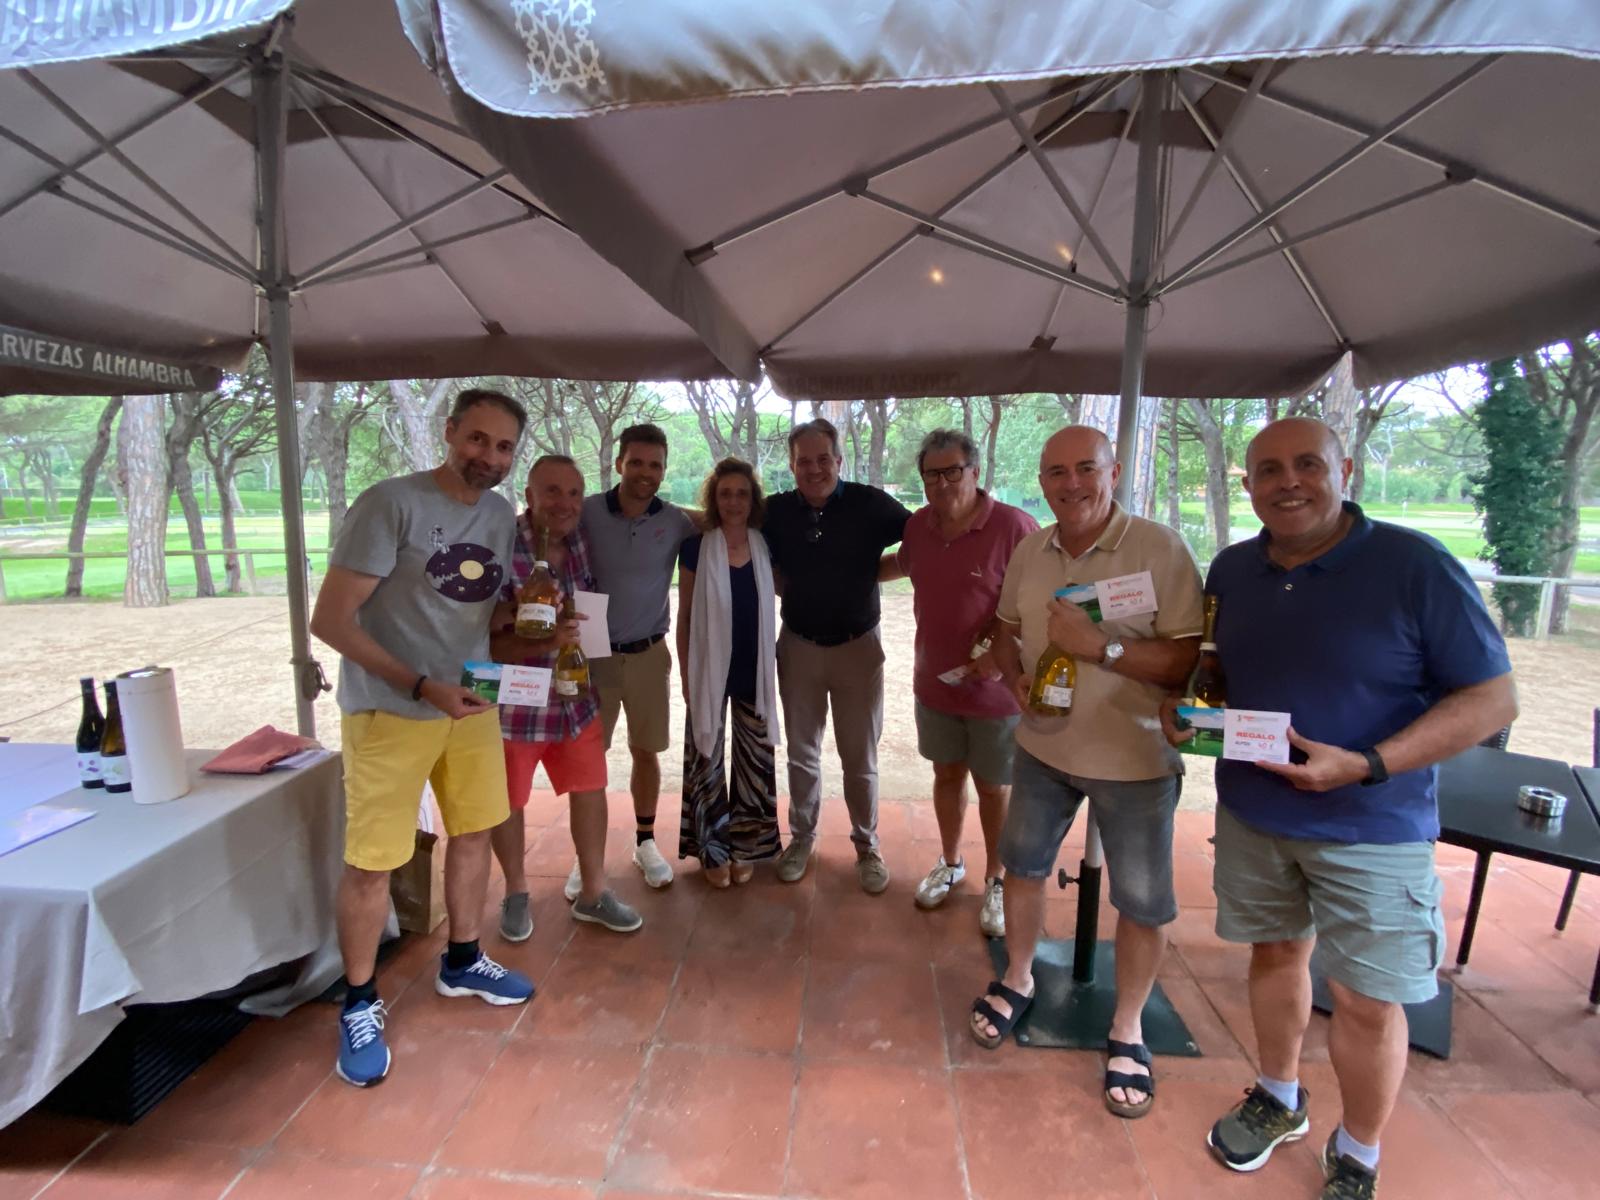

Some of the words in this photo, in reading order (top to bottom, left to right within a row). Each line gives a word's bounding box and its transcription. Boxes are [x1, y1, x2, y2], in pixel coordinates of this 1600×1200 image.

[0, 333, 84, 369] RVEZAS
[92, 351, 196, 387] ALHAMBRA
[1236, 732, 1275, 740] REGALO
